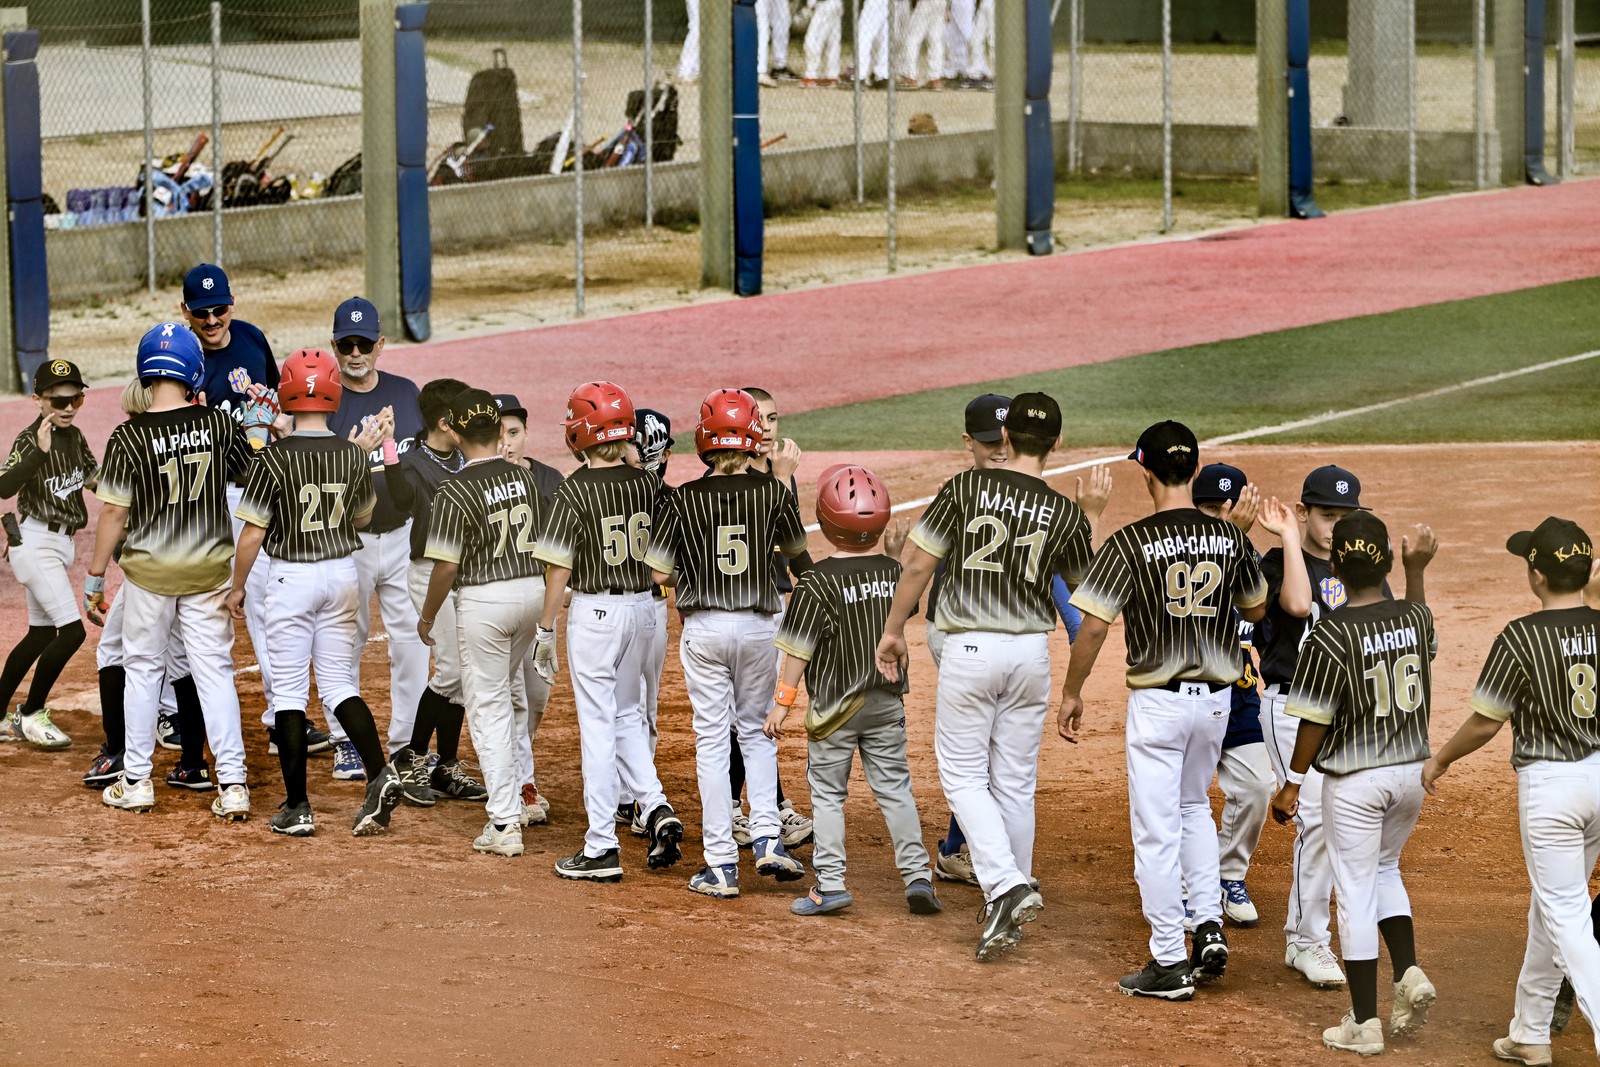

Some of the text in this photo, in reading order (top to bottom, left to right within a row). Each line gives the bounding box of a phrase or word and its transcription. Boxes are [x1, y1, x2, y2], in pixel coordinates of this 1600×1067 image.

[160, 341, 170, 350] 17
[458, 404, 500, 428] KALEN
[152, 429, 211, 455] M.PACK
[158, 451, 211, 504] 17
[484, 480, 527, 506] KALEN
[299, 483, 347, 533] 27
[487, 503, 537, 558] 72
[979, 490, 1055, 527] MAHE
[600, 511, 651, 567] 56
[717, 524, 748, 576] 5
[963, 515, 1046, 583] 21
[1337, 538, 1385, 565] AARON
[843, 580, 896, 605] M.PACK
[1165, 561, 1223, 618] 92
[1363, 626, 1418, 657] AARON
[1363, 653, 1422, 717] 16
[1567, 663, 1597, 719] 8
